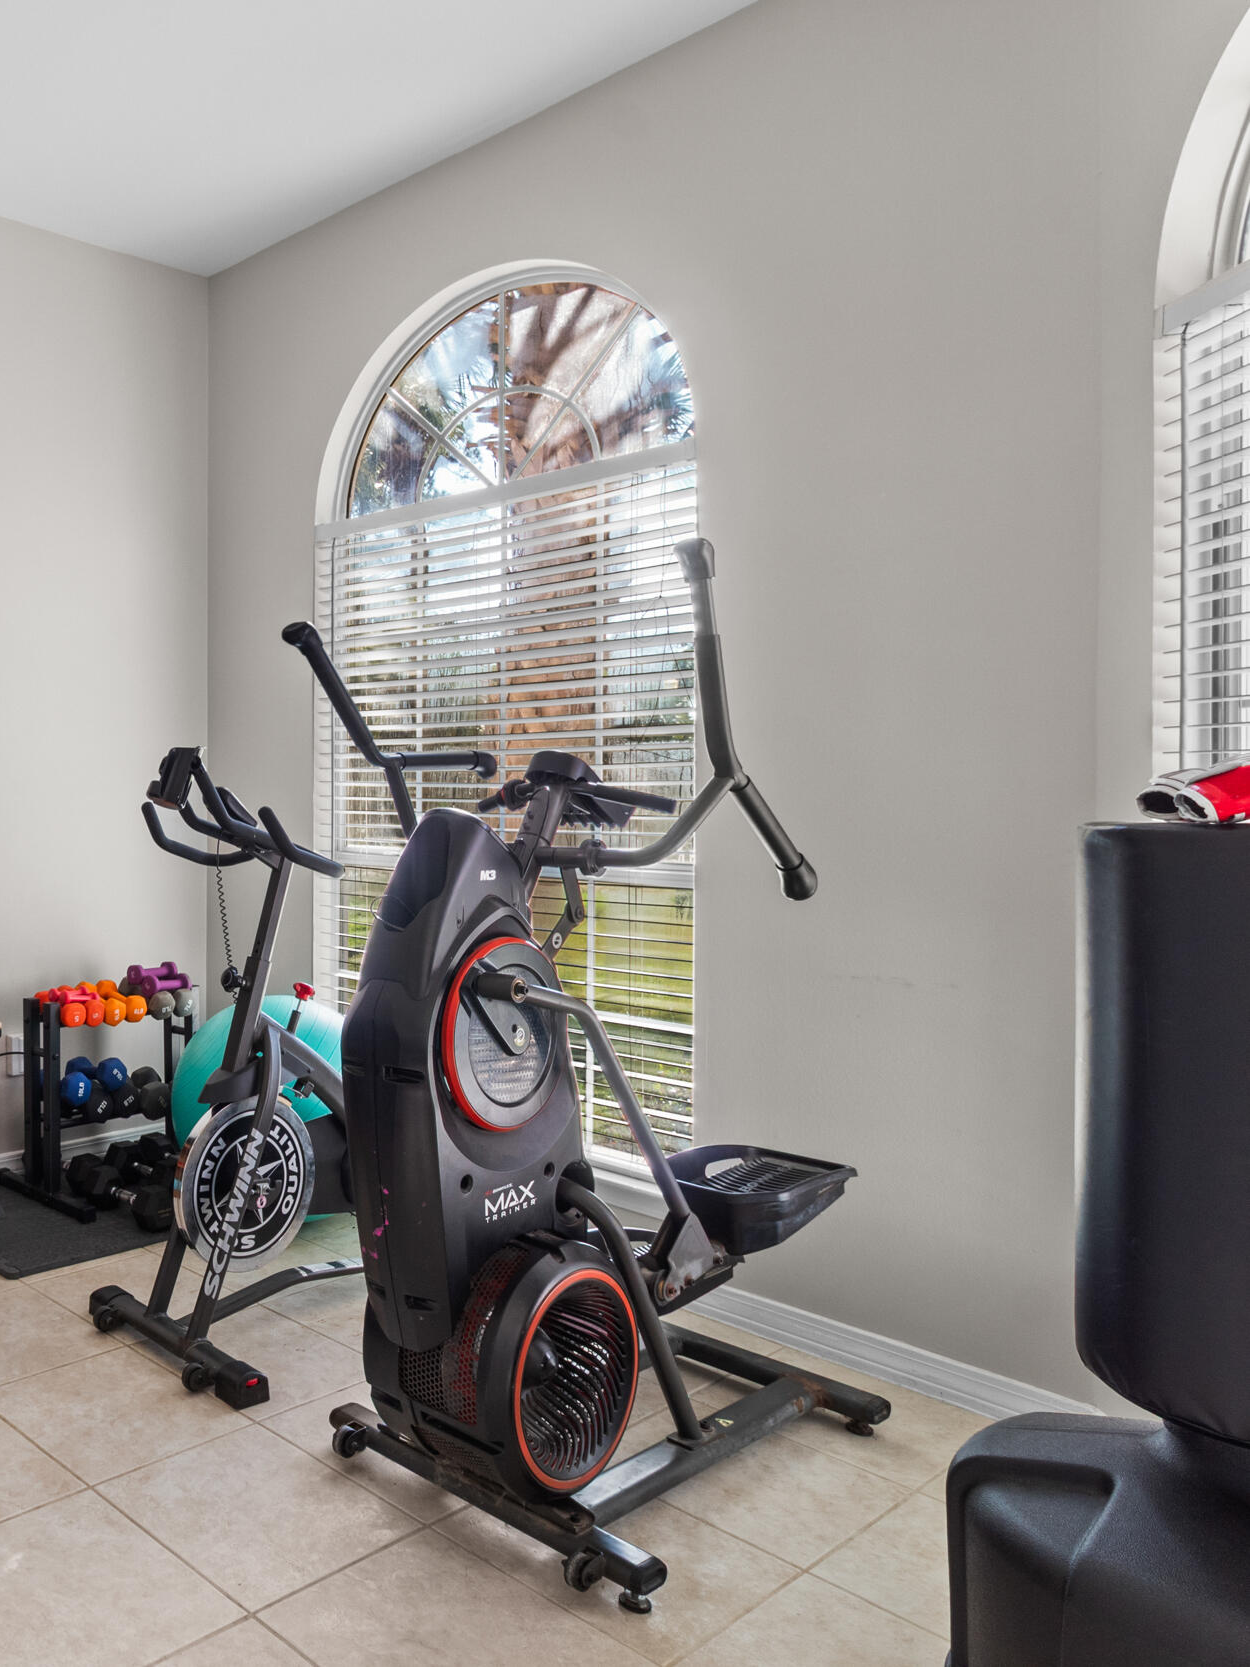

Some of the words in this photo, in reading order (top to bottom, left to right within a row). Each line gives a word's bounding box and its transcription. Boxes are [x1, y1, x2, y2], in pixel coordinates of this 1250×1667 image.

[480, 869, 496, 881] M3
[269, 1125, 299, 1215] QUALIT
[204, 1128, 265, 1299] SCHWINN
[484, 1180, 535, 1217] MAX
[485, 1198, 536, 1223] TRAINER
